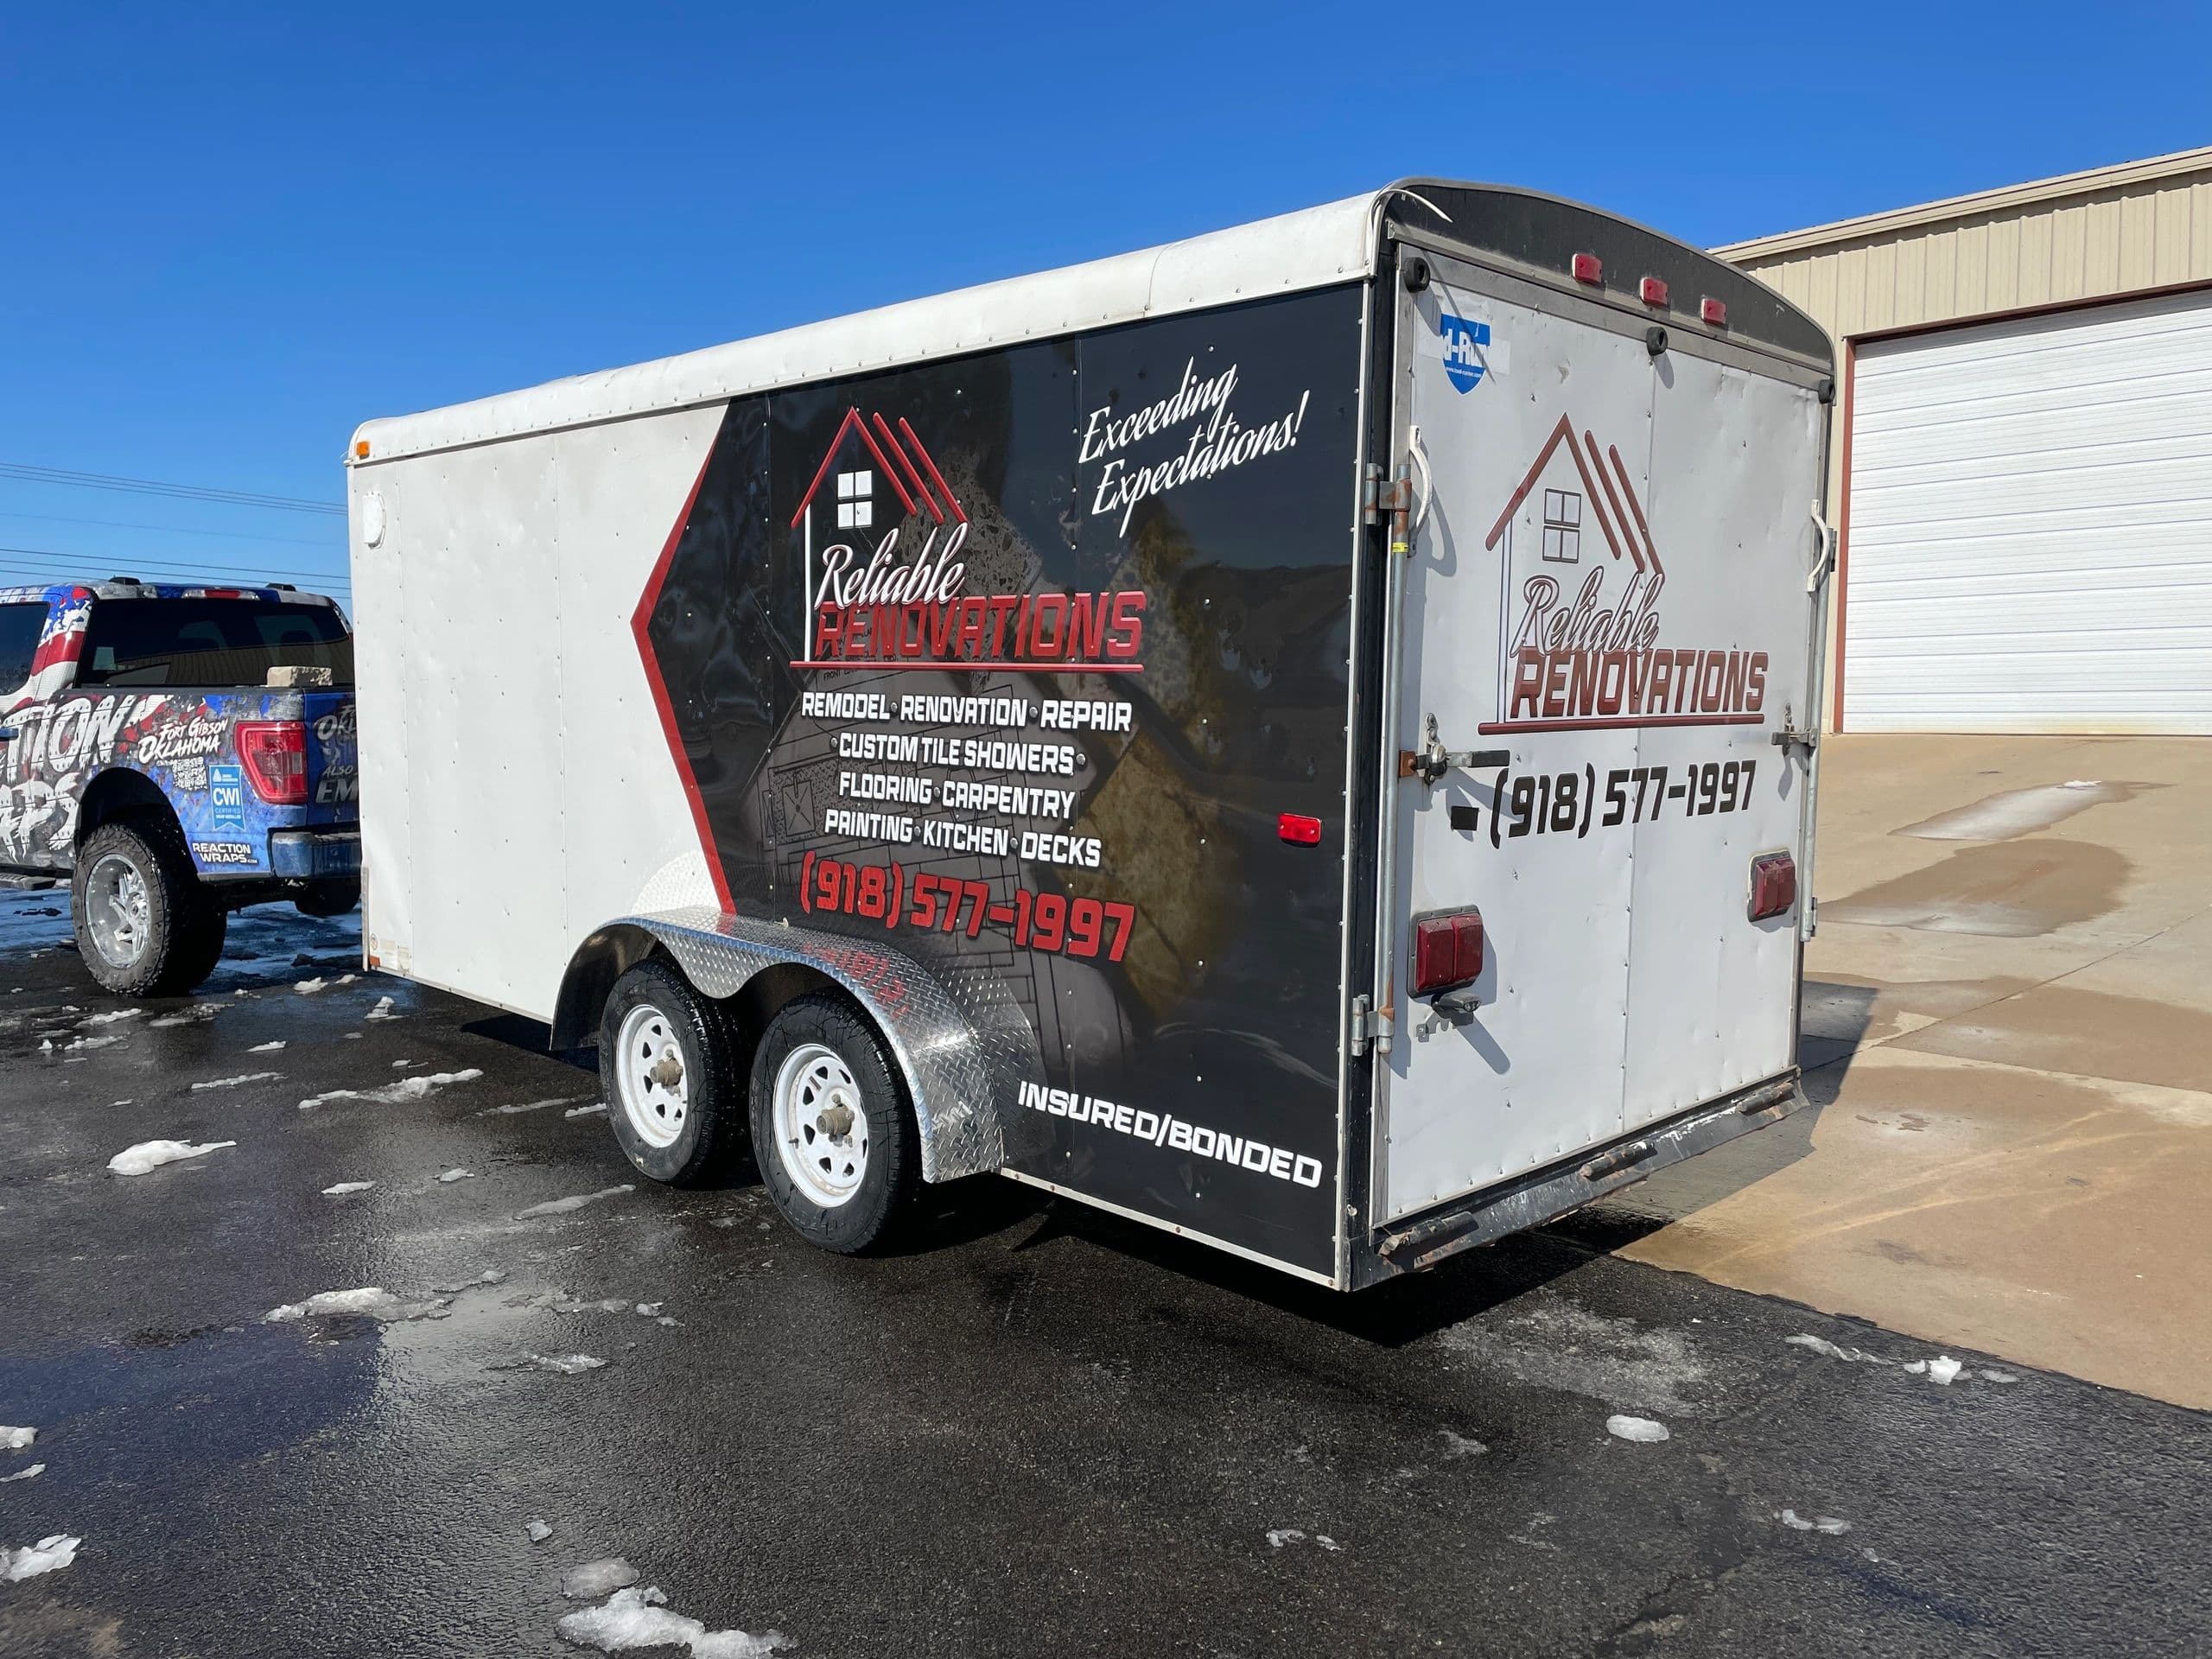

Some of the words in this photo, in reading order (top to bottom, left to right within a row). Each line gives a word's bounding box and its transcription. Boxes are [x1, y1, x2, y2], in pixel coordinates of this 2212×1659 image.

[1078, 356, 1238, 464] Exceeding
[1091, 389, 1310, 538] Expectations!
[814, 521, 969, 610] Reliable
[815, 589, 1147, 659] RENOVATIONS
[1510, 565, 1665, 658] Reliable
[801, 691, 891, 721] REMODEL
[899, 695, 1028, 728] RENOVATION
[1040, 699, 1133, 732] REPAIR
[1510, 646, 1769, 719] RENOVATIONS
[1, 695, 137, 784] TION
[138, 734, 221, 764] OKLAHOMA
[160, 720, 188, 741] FORT
[188, 715, 229, 737] GIBSON
[839, 732, 918, 763] CUSTOM
[920, 736, 960, 766] TILE
[963, 739, 1075, 775] SHOWERS
[213, 787, 240, 806] CWI
[322, 765, 353, 776] ALSO
[838, 772, 932, 805] FLOORING
[942, 780, 1076, 820] CARPENTRY
[1490, 761, 1596, 850] (918)
[1601, 759, 1757, 828] 577-1997
[192, 842, 251, 854] REACTION
[823, 809, 914, 844] PAINTING
[923, 820, 1010, 857] KITCHEN
[1020, 831, 1102, 868] DECKS
[800, 850, 905, 930] (918)
[910, 873, 1135, 963] 577-1997
[1018, 1079, 1323, 1189] INSURED/BONDED
